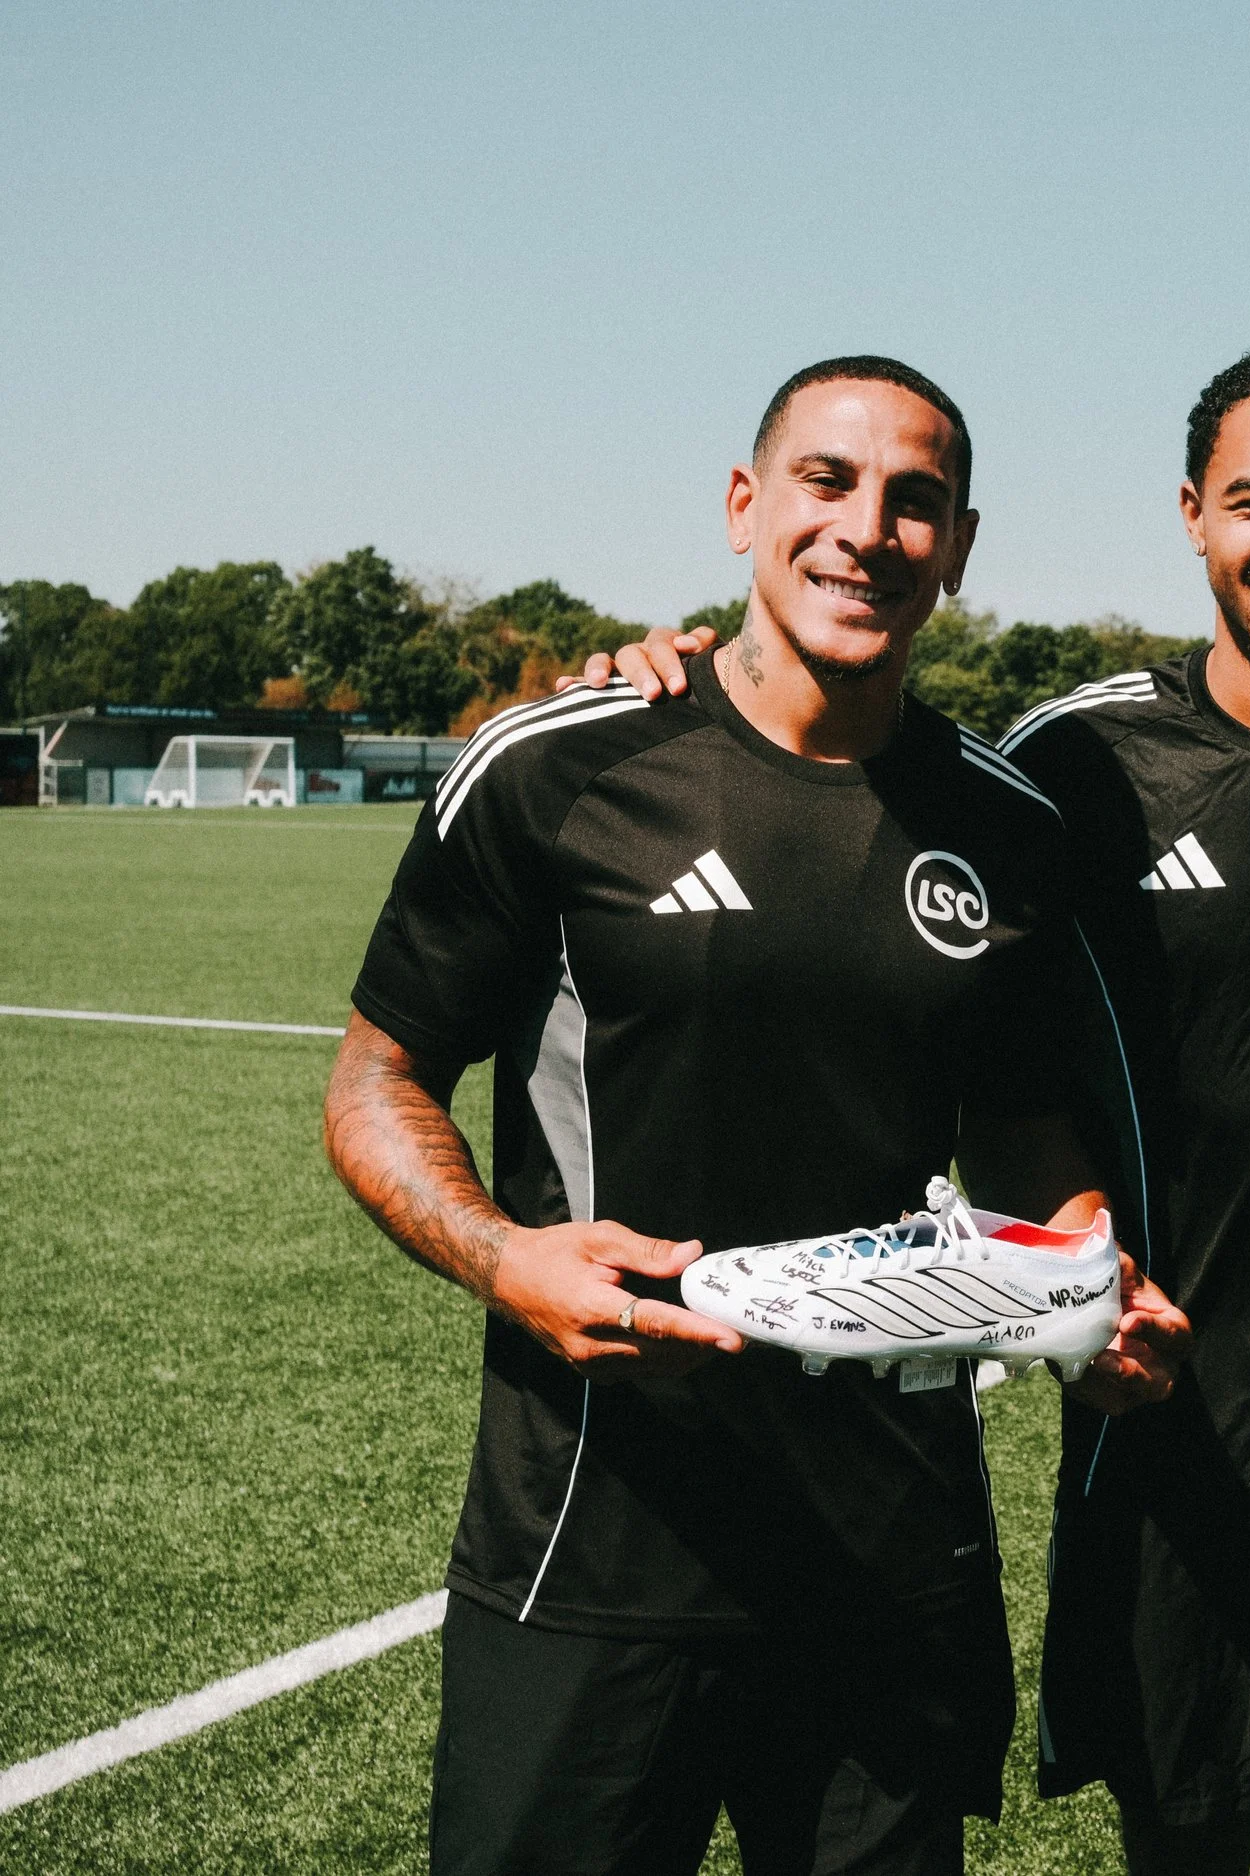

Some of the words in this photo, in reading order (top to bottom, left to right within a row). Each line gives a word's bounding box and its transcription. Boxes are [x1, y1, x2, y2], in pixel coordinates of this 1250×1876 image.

[918, 879, 988, 930] LSC
[1002, 1279, 1047, 1307] PREDATOR
[1048, 1288, 1071, 1309] NP
[829, 1319, 867, 1332] EVANS
